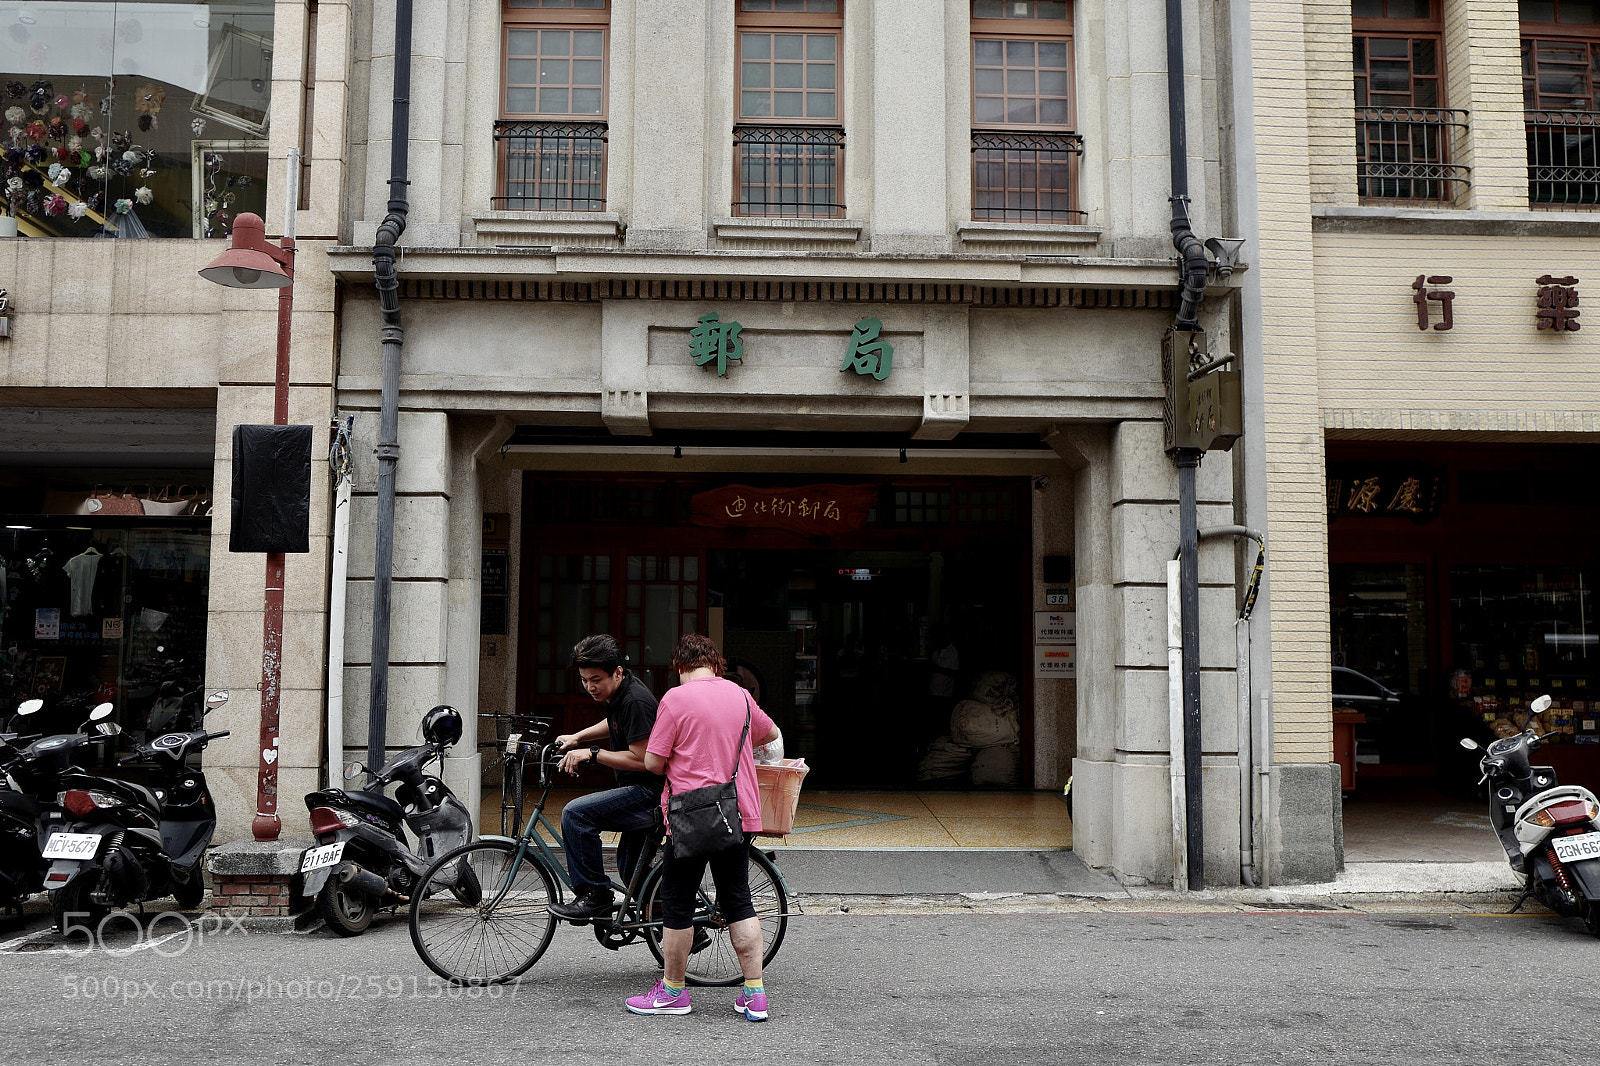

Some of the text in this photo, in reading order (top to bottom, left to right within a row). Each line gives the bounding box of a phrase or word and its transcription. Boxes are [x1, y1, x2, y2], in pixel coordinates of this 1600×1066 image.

[688, 311, 895, 381] 郵局
[725, 495, 840, 520] 迪化街郵局
[1051, 595, 1064, 603] 38
[302, 848, 342, 869] 211-BAF
